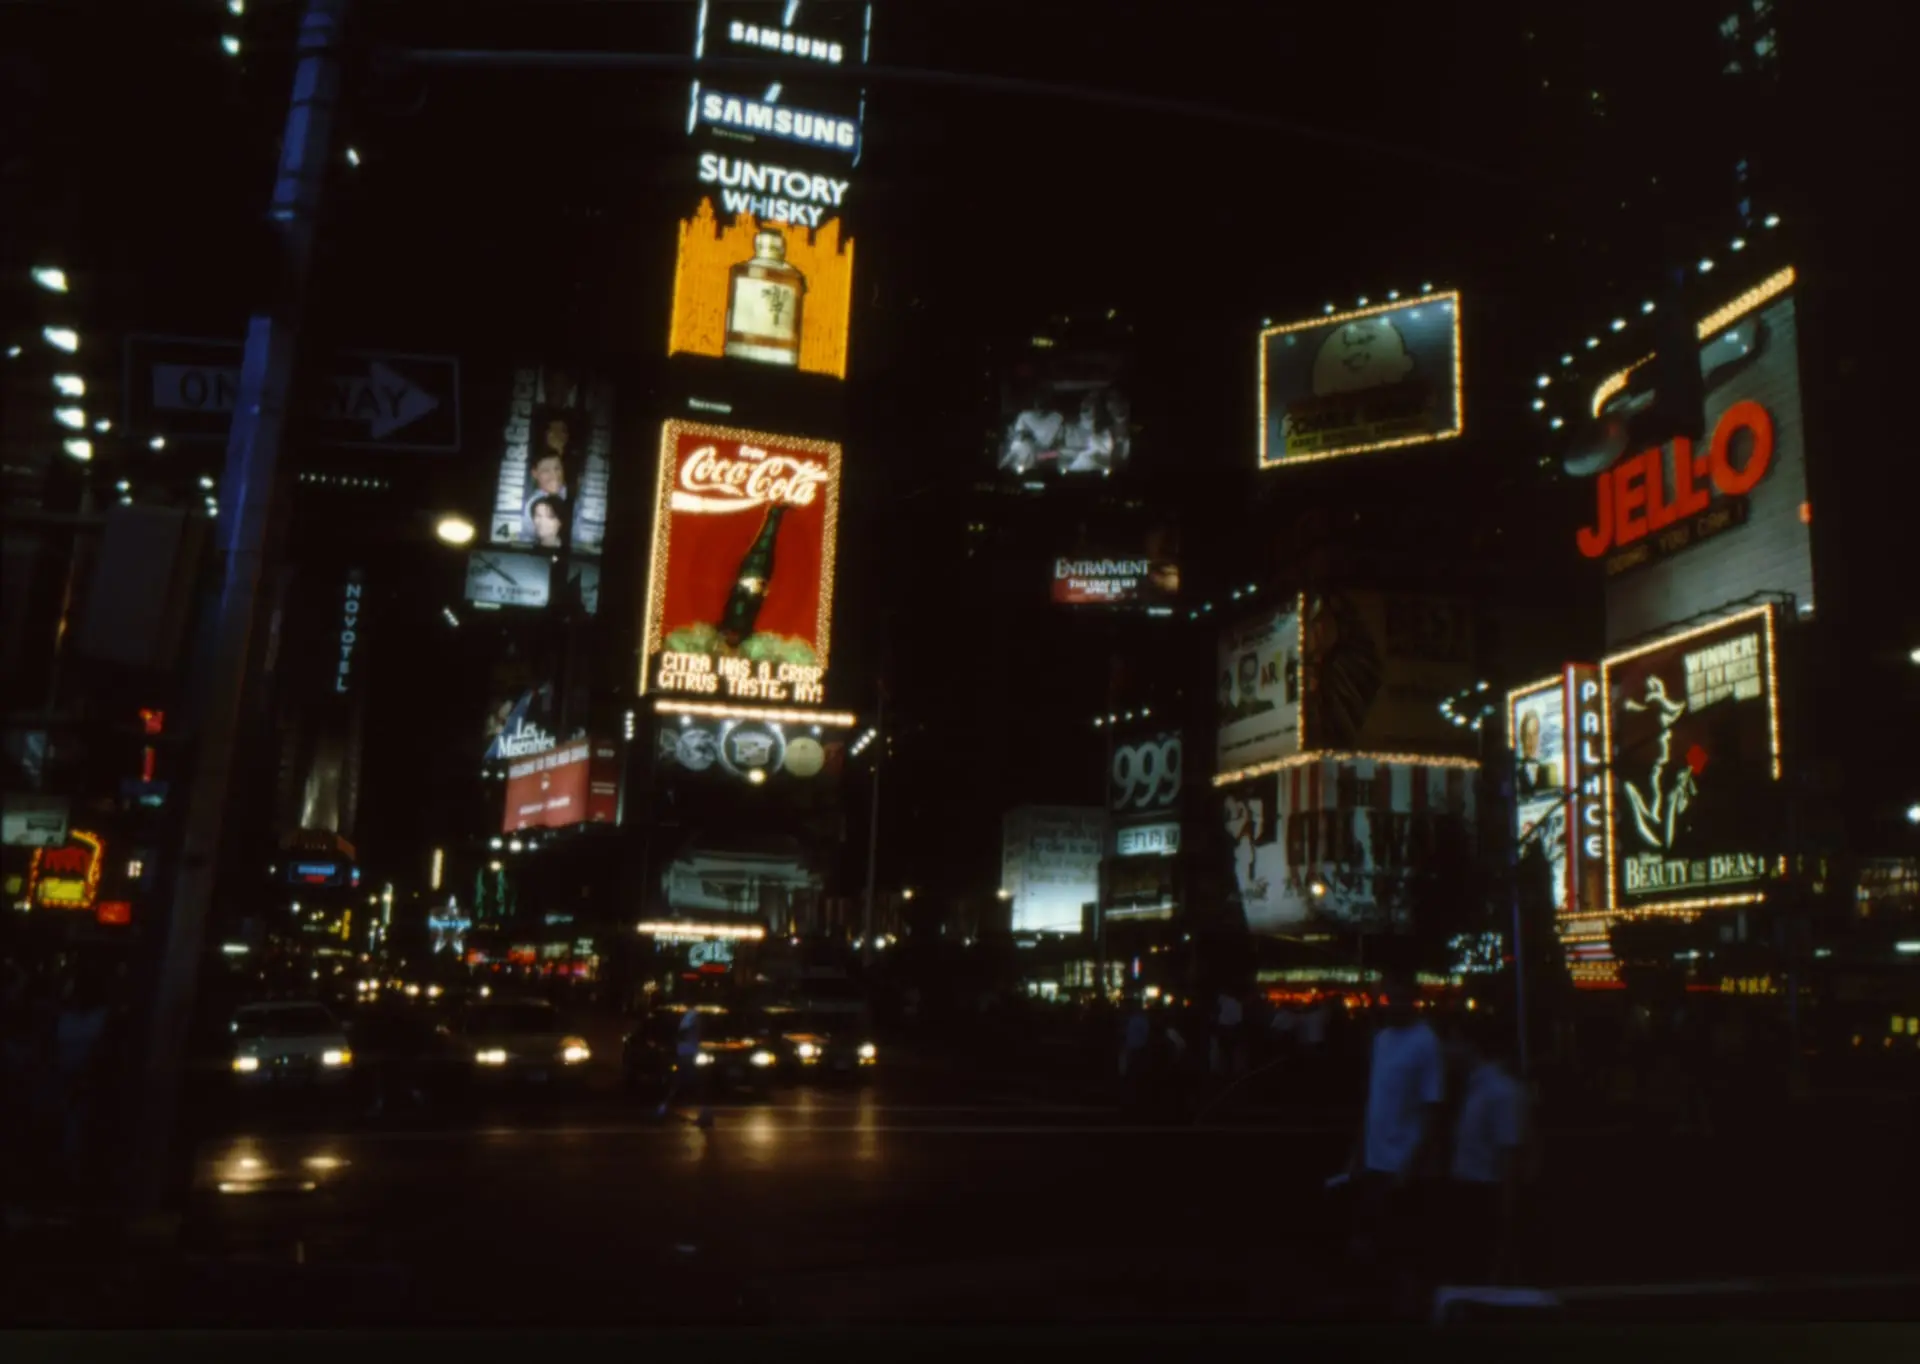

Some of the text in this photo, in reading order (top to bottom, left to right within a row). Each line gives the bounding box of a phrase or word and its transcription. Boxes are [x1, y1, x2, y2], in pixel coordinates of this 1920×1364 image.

[728, 20, 844, 63] SAMSUNG
[702, 93, 856, 148] SAMSUNG
[699, 153, 850, 206] SUNTORY
[722, 189, 824, 227] WHISKY
[180, 371, 241, 407] ON
[681, 445, 828, 505] Coca-Cola
[1576, 399, 1774, 558] JELL-O
[1055, 556, 1149, 579] ENTRAPMENT
[334, 581, 363, 693] NOVOTEL
[658, 668, 718, 693] CITRUS
[662, 651, 824, 684] CITRA HAS A CRISP
[515, 716, 537, 739] Les
[1581, 680, 1604, 859] PALACE
[1625, 855, 1690, 890] BEAUTY
